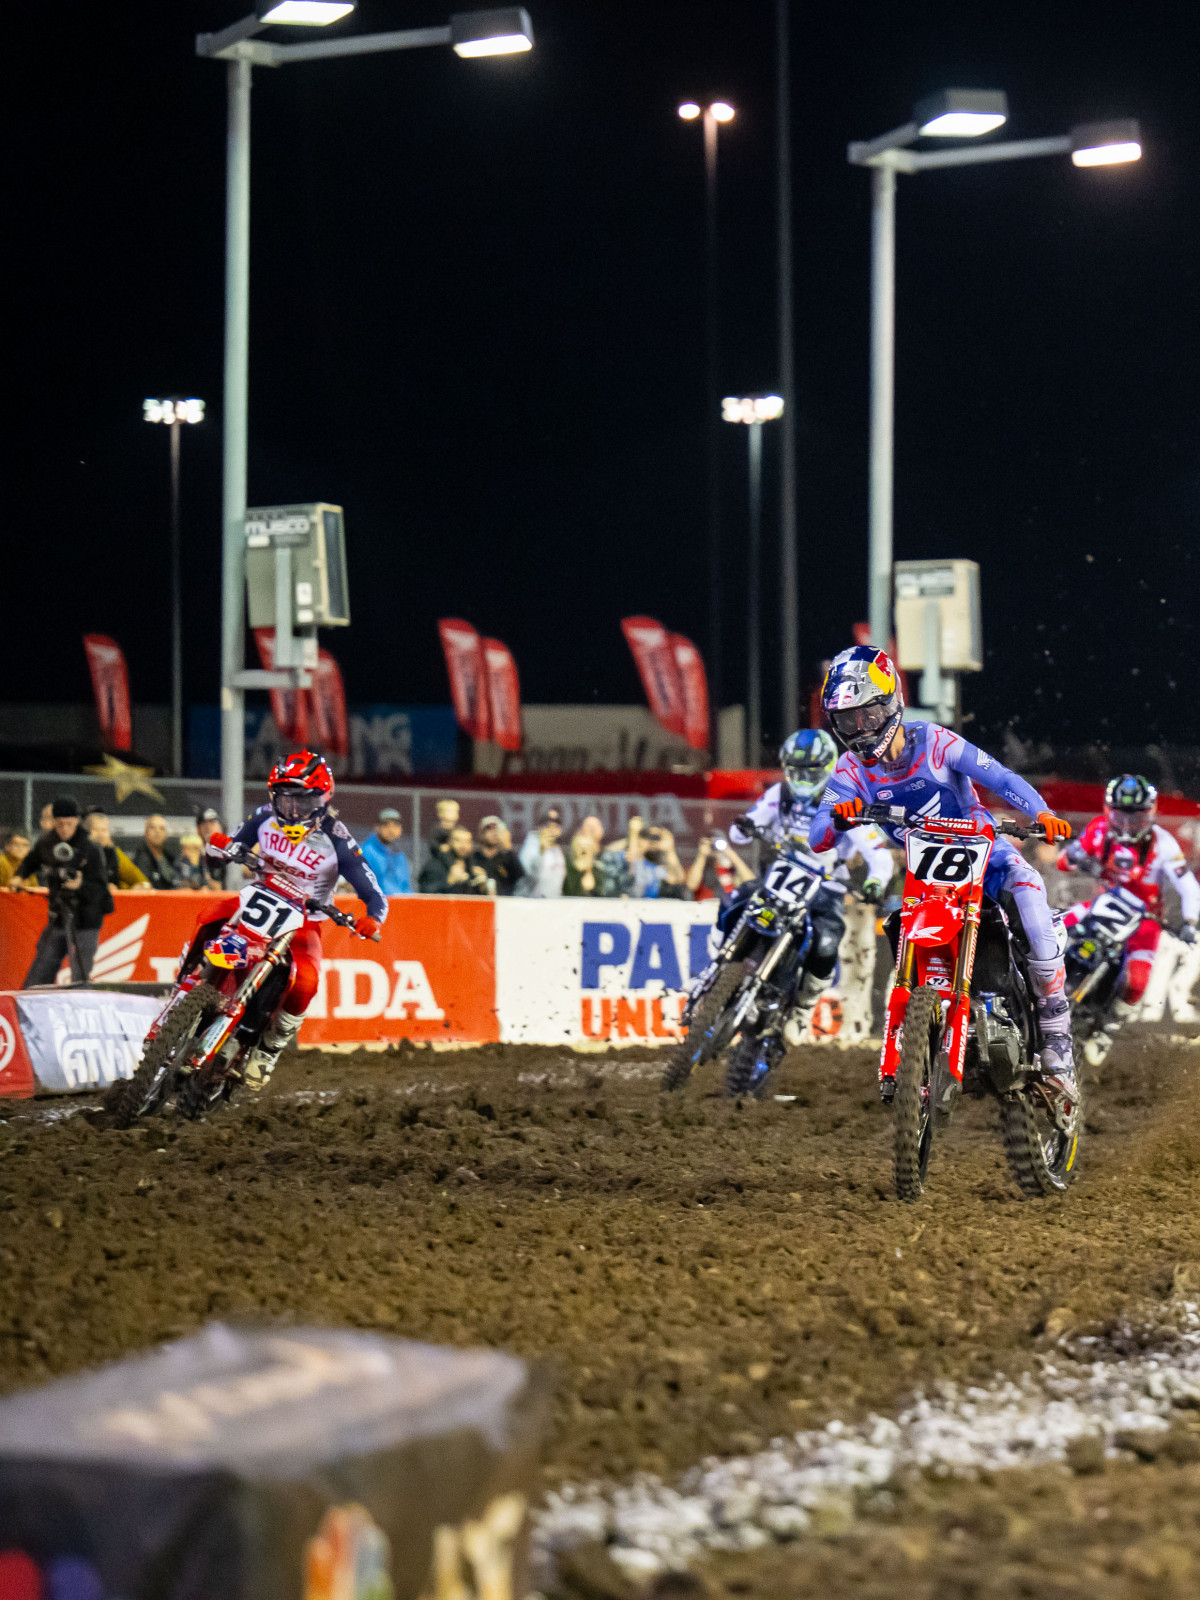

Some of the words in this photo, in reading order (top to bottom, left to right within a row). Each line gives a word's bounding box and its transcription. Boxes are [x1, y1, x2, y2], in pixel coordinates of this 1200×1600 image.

[297, 845, 326, 871] LEE
[914, 846, 979, 882] 18
[768, 864, 812, 903] 14
[241, 890, 293, 938] 51
[957, 1014, 968, 1075] DUNLOP
